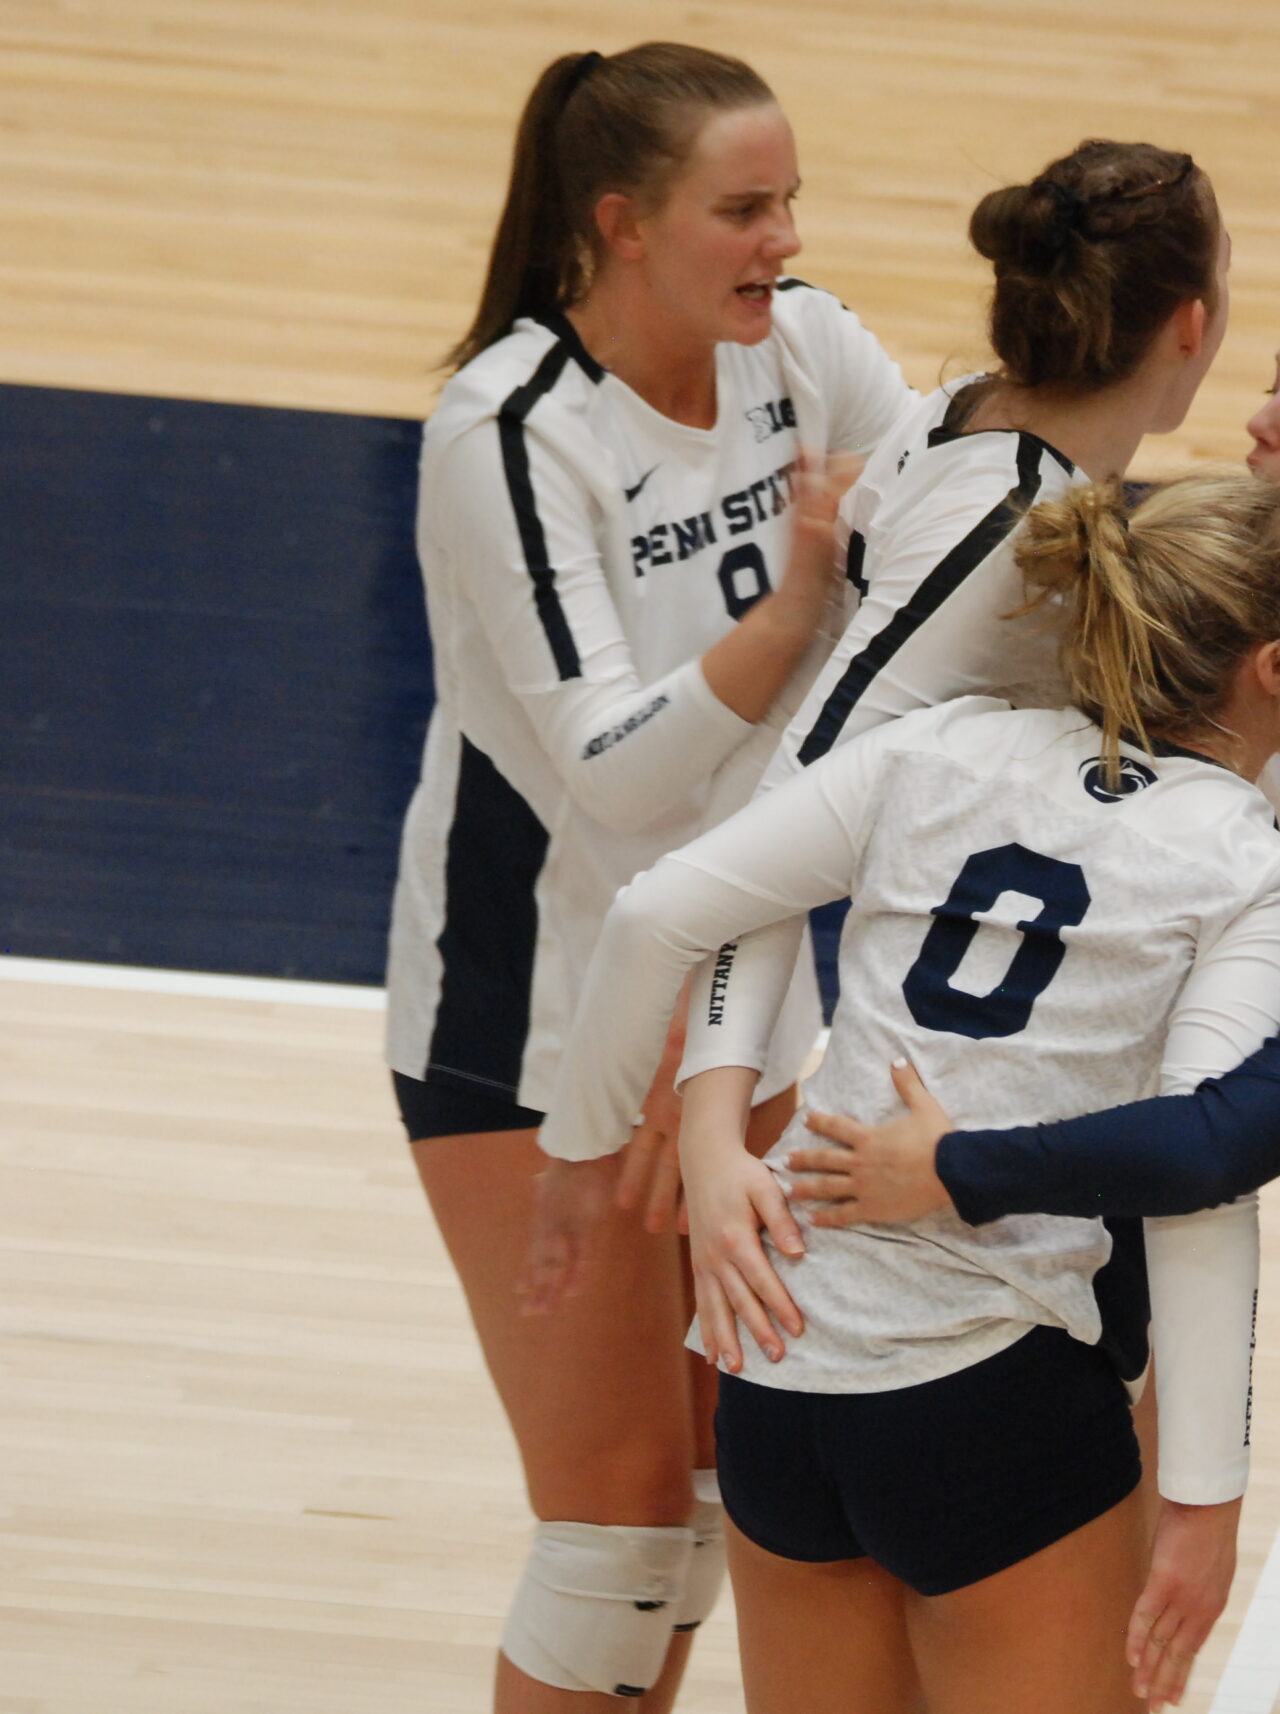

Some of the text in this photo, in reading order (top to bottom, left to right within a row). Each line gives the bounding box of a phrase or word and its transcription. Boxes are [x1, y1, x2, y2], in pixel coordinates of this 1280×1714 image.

[721, 461, 798, 535] STAT
[902, 842, 1091, 1040] 0
[708, 943, 738, 1026] NITTANY
